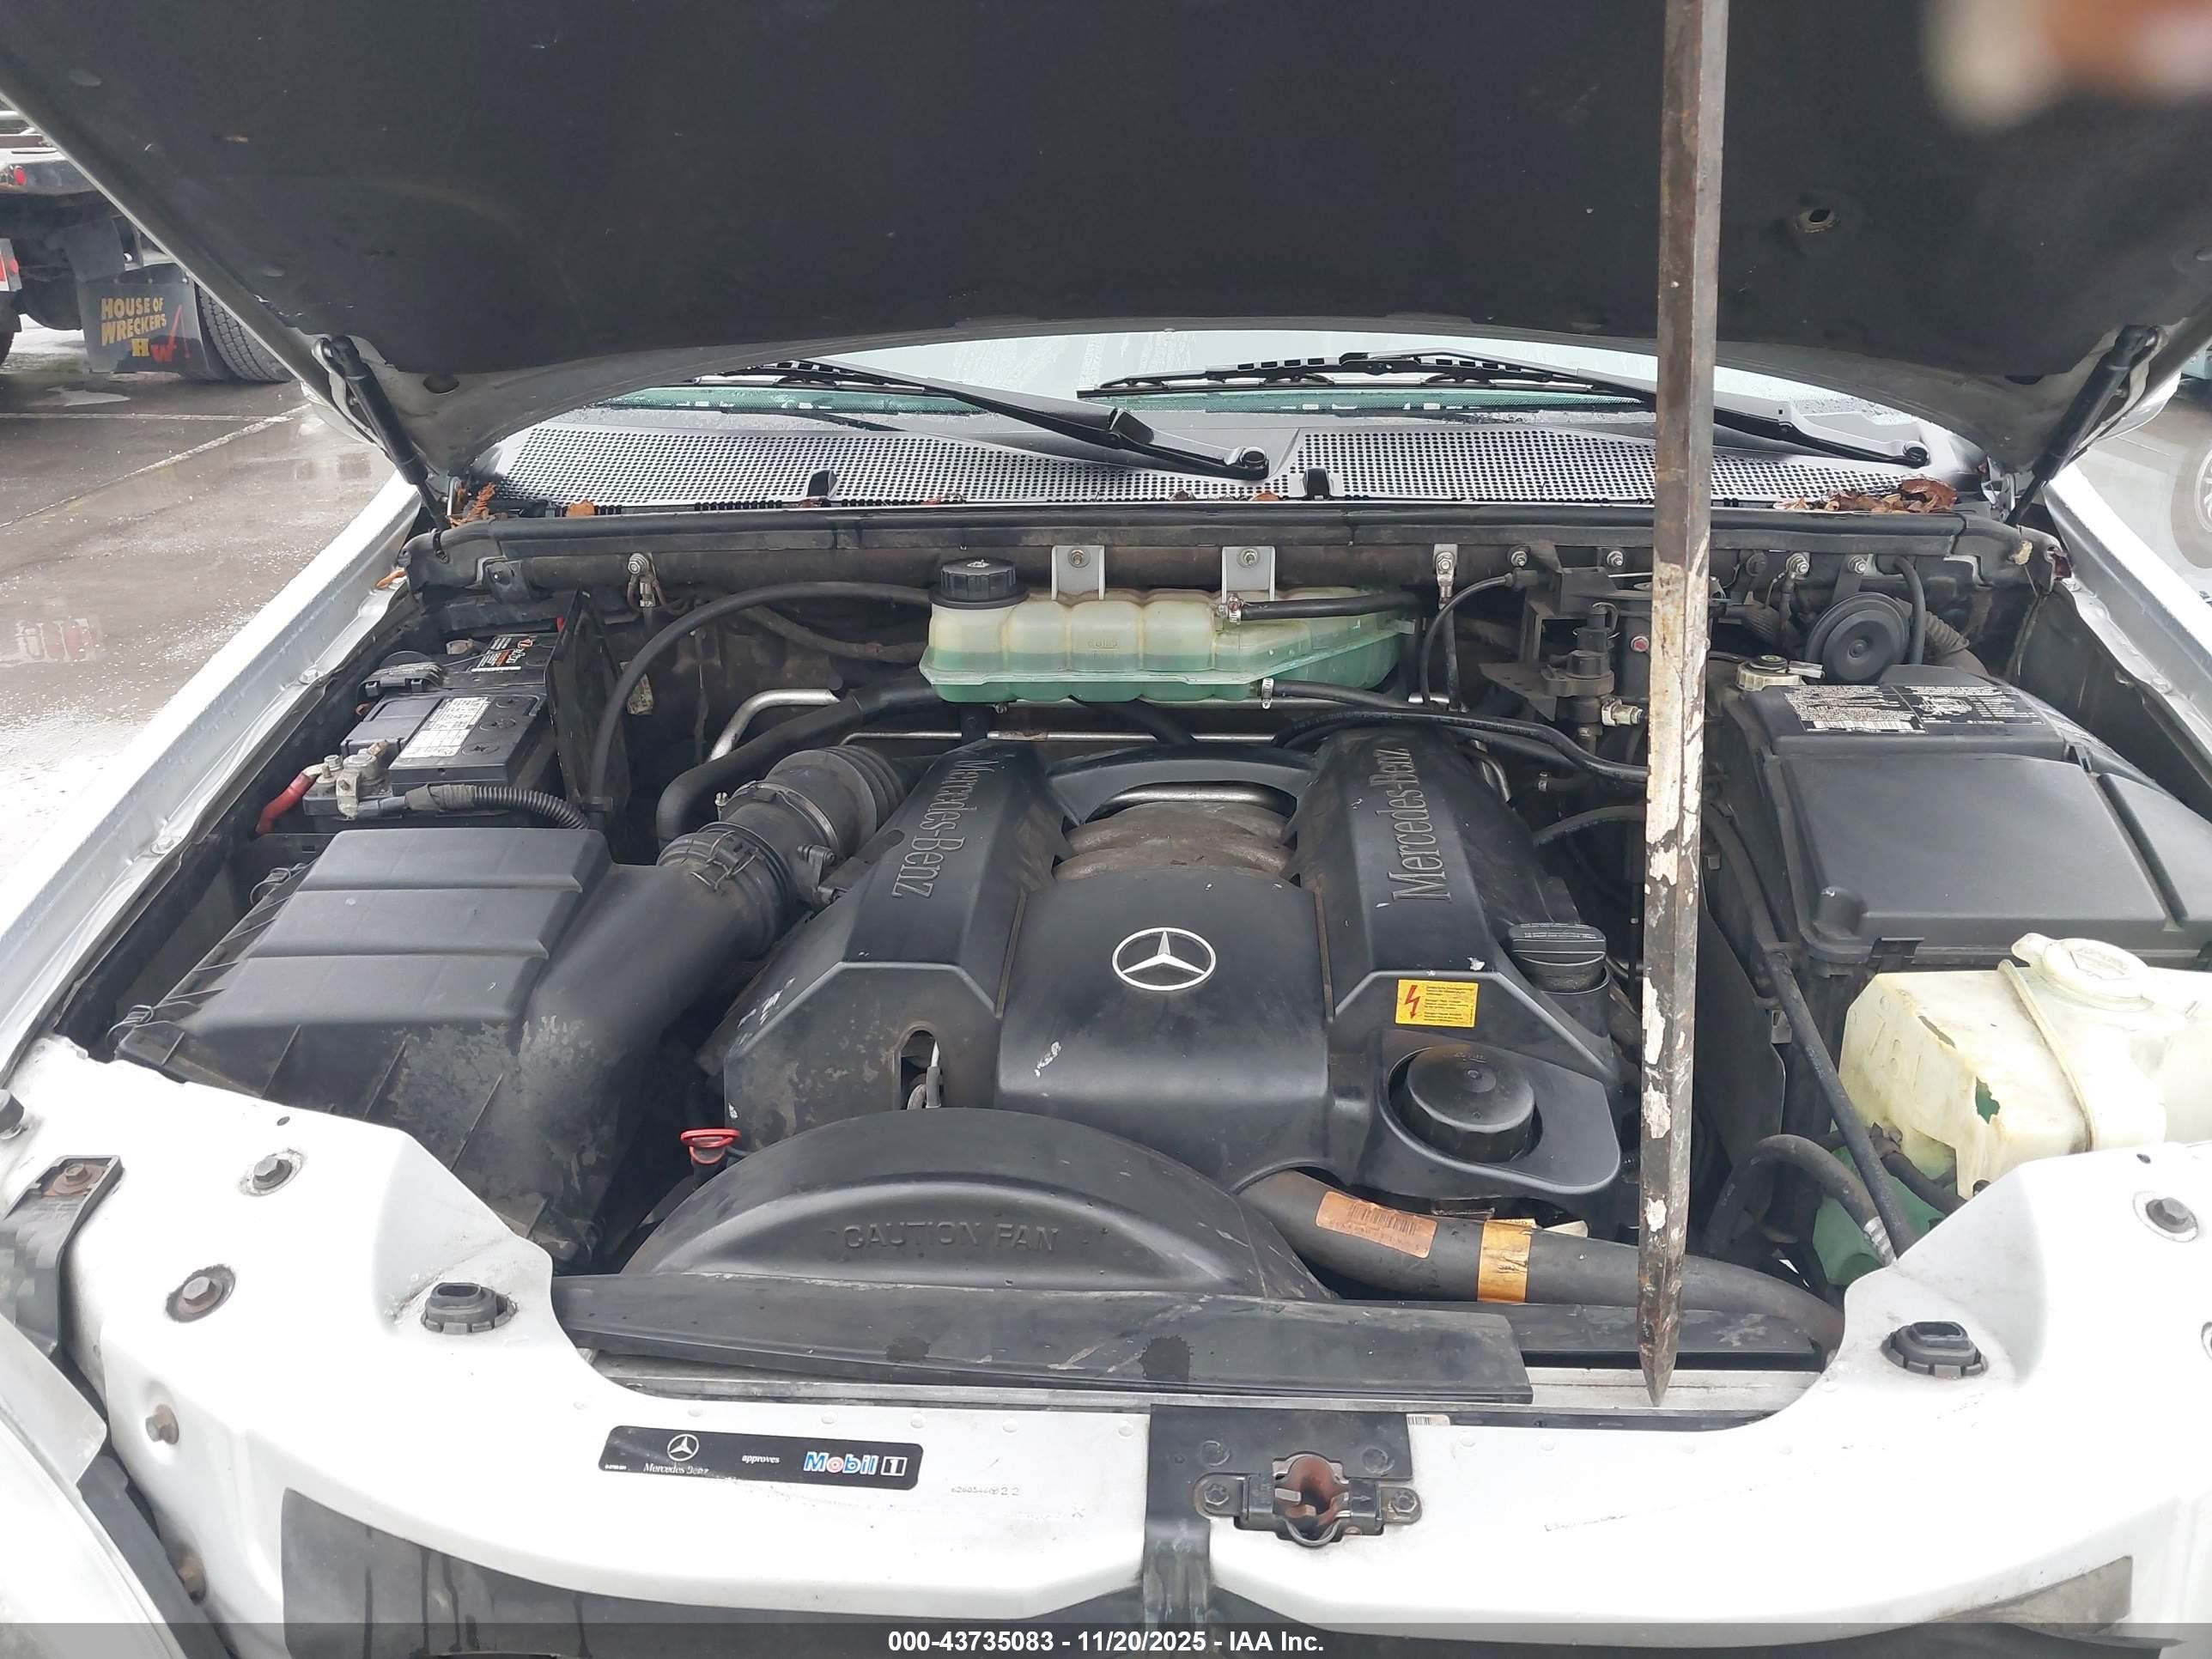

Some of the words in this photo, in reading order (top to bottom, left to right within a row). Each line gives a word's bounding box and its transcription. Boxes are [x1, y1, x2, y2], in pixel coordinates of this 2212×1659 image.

[101, 297, 150, 320] HOUSE
[152, 297, 164, 312] OF
[101, 313, 167, 346] WRECKERS
[891, 759, 1000, 898] Mercedes-Benz
[1369, 748, 1452, 902] Mercedes-Benz
[844, 1221, 981, 1248] CAUTION
[996, 1223, 1059, 1251] FAN
[741, 1455, 781, 1465] approves
[803, 1451, 878, 1475] Mobil
